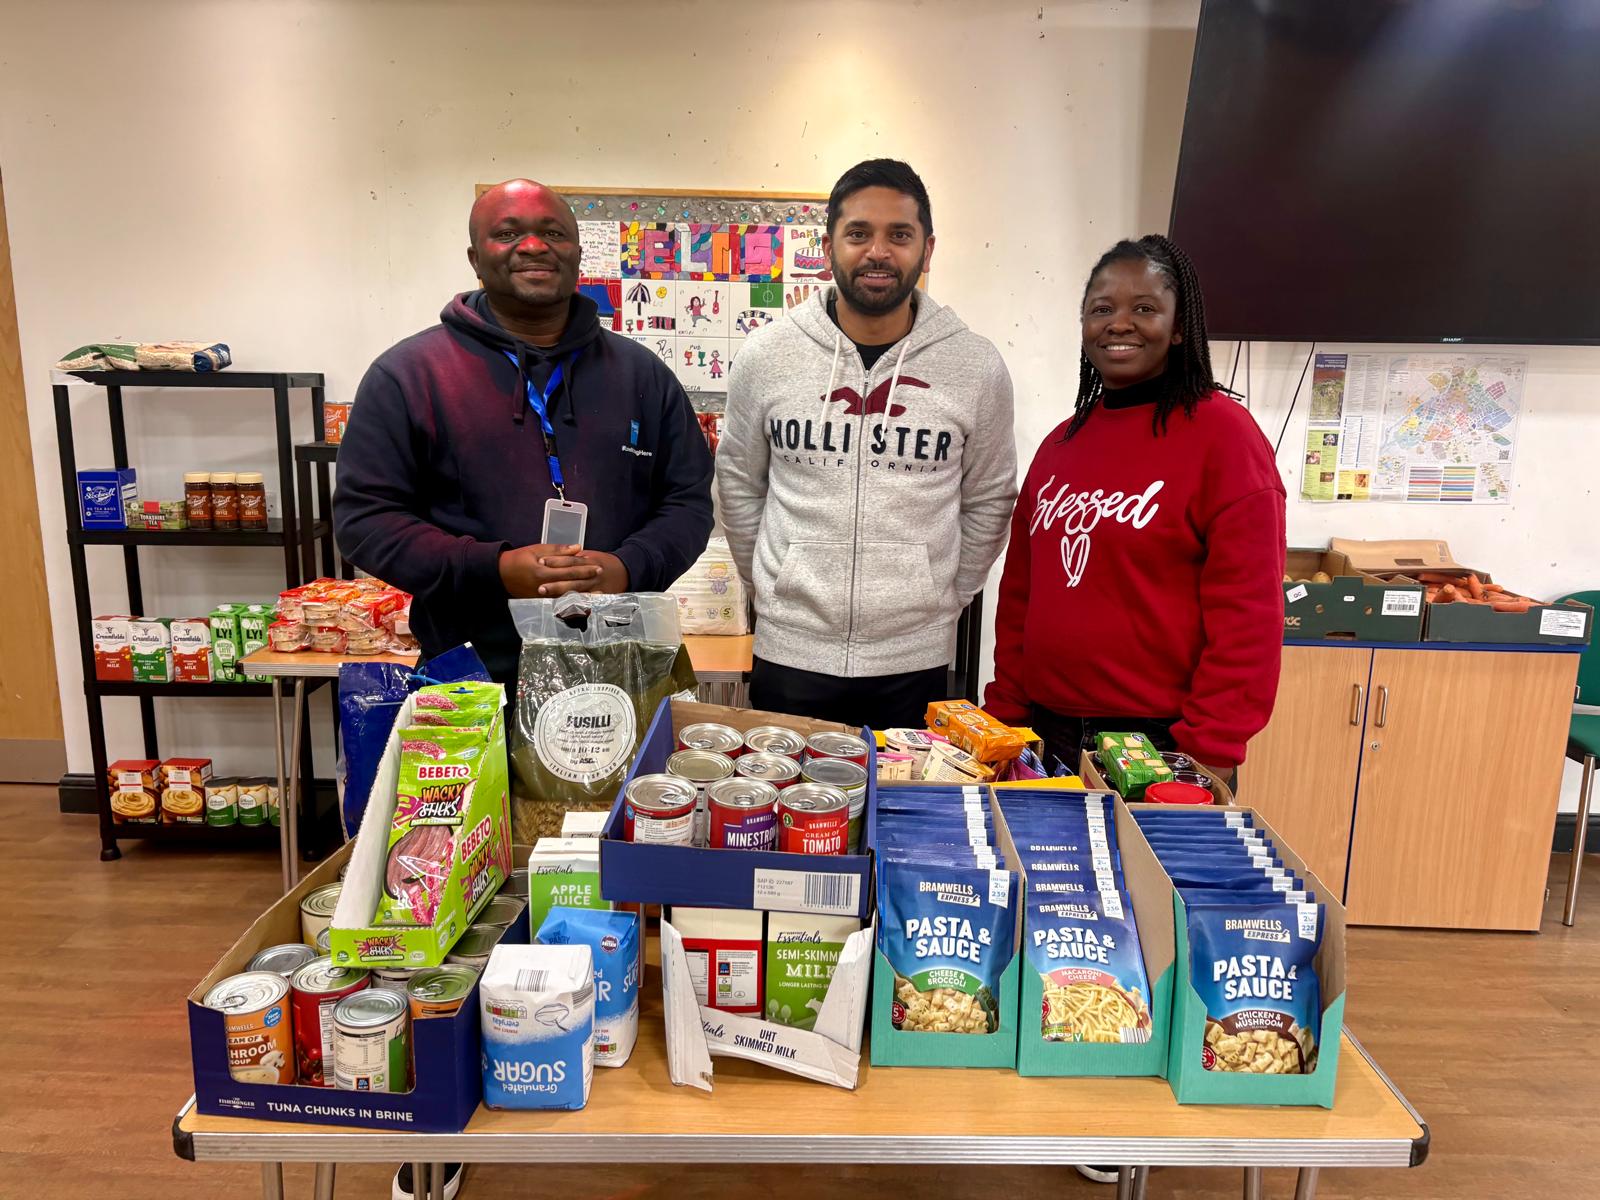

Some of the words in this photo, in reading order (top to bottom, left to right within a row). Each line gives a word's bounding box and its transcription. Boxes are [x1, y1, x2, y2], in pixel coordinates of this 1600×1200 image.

[791, 229, 819, 240] BAKE
[770, 419, 951, 461] HOLLISTER
[784, 455, 938, 472] CALIFORNIA
[216, 629, 233, 639] LY!
[246, 630, 263, 640] LY!
[566, 714, 611, 729] FUSILLI
[419, 766, 469, 779] BEBETO
[549, 763, 578, 779] ITALIAN
[422, 783, 465, 803] WACKY
[419, 797, 460, 817] STICKS
[809, 820, 837, 830] BRAMWELLS
[461, 816, 491, 863] BEBETO
[803, 836, 841, 854] TOMATO
[537, 864, 574, 875] Essentials
[550, 885, 592, 895] APPLE
[919, 882, 973, 895] BRAMWELLS
[1035, 883, 1084, 892] BRAMWELLS
[552, 896, 591, 906] JUICE
[941, 894, 970, 904] EXPRESS
[1039, 904, 1089, 914] BRAMWELLS
[906, 917, 974, 940] PASTA
[977, 928, 992, 946] &
[1225, 919, 1282, 931] BRAMWELLS
[777, 930, 823, 944] Essentials
[1034, 927, 1099, 947] PASTA
[1103, 934, 1116, 950] &
[1247, 930, 1279, 941] EXPRESS
[776, 949, 841, 962] SEMI-SKIMM
[915, 938, 981, 963] SAUCE
[1047, 943, 1109, 964] SAUCE
[785, 963, 836, 979] MILK
[929, 970, 958, 978] CHEESE
[1213, 955, 1286, 982] PASTA
[1287, 965, 1298, 980] &
[927, 977, 967, 988] BROCCOLI
[1224, 977, 1293, 1001] SAUCE
[893, 1007, 899, 1017] 5
[1237, 1011, 1274, 1020] CHICKEN
[1235, 1019, 1284, 1029] MUSHROOM
[759, 1029, 778, 1042] UHT
[230, 1038, 277, 1059] HROOM
[734, 1035, 774, 1054] SKIMMED
[774, 1046, 798, 1060] MILK
[494, 1059, 567, 1083] SUGAR
[503, 1083, 558, 1095] Granulated
[219, 1098, 255, 1107] FISHMONGER
[267, 1102, 301, 1113] TUNA
[305, 1104, 355, 1117] CHUNKS
[359, 1109, 372, 1119] IN
[375, 1110, 414, 1122] BRINE
